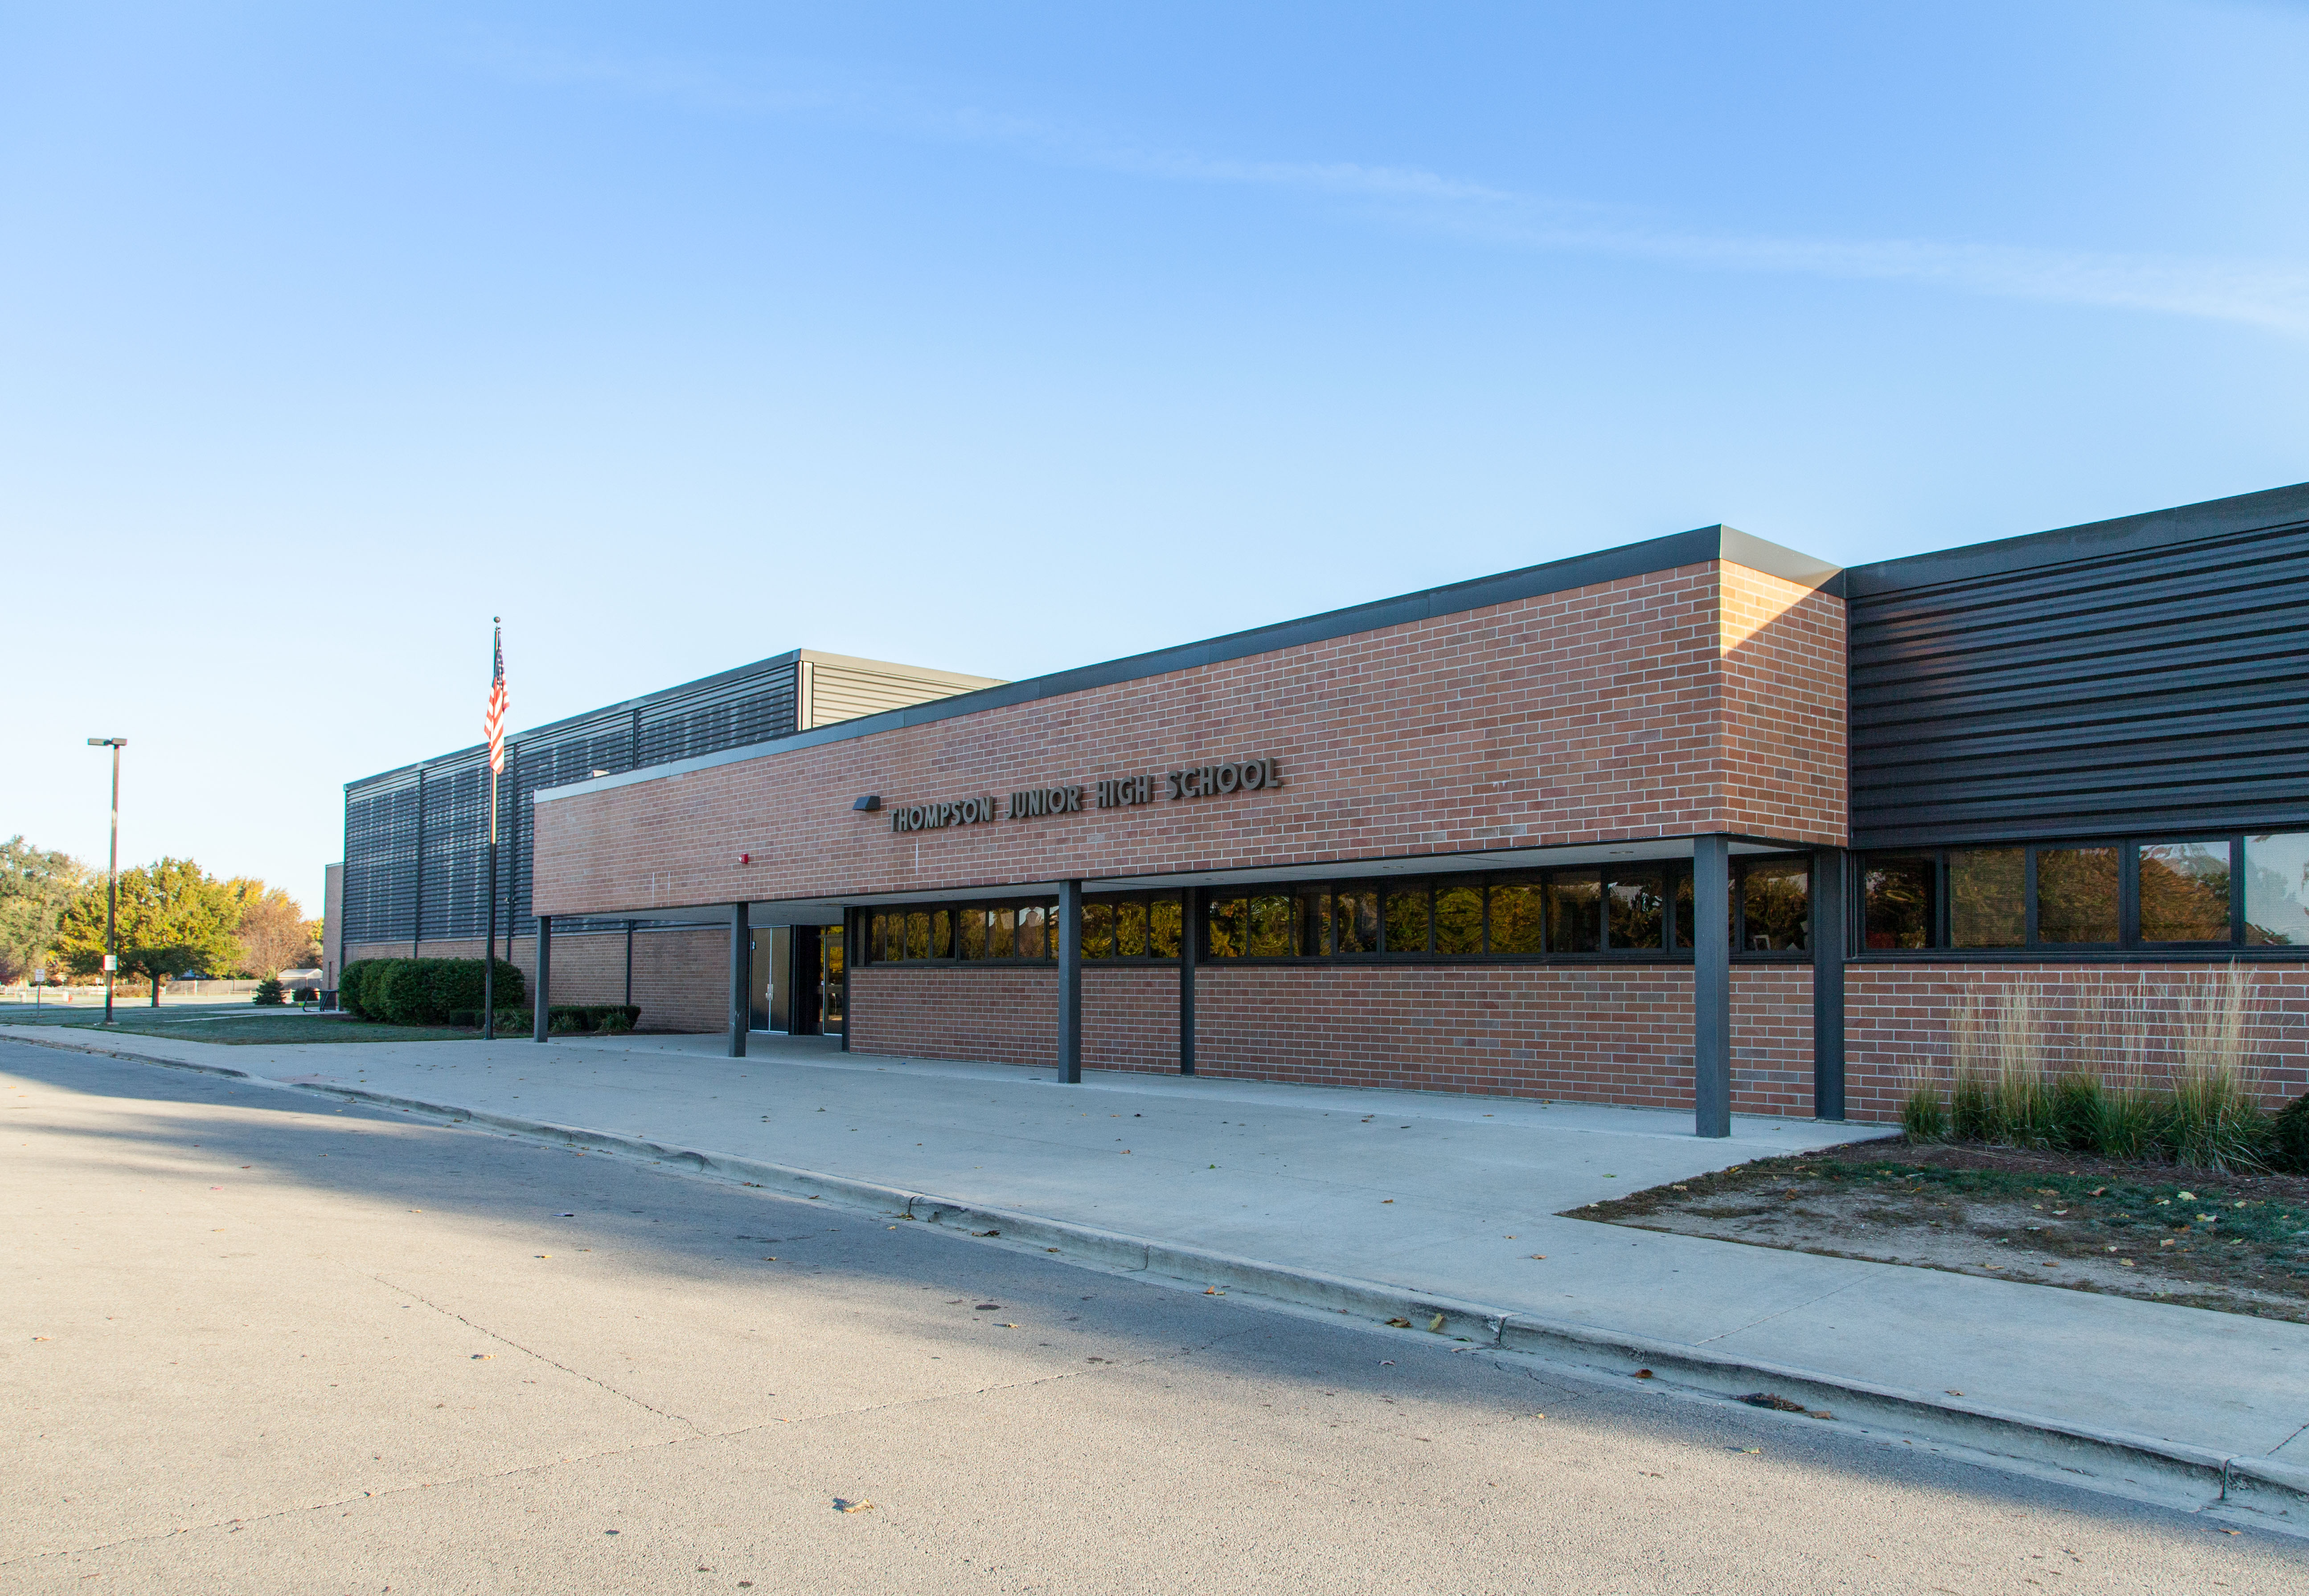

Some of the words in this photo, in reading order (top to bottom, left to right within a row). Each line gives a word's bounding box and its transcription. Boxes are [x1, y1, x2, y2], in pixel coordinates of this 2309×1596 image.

[888, 796, 993, 831] THOMPSON
[1004, 785, 1082, 818] JUNIOR
[1095, 775, 1152, 808] HIGH
[1165, 757, 1281, 800] SCHOOL
